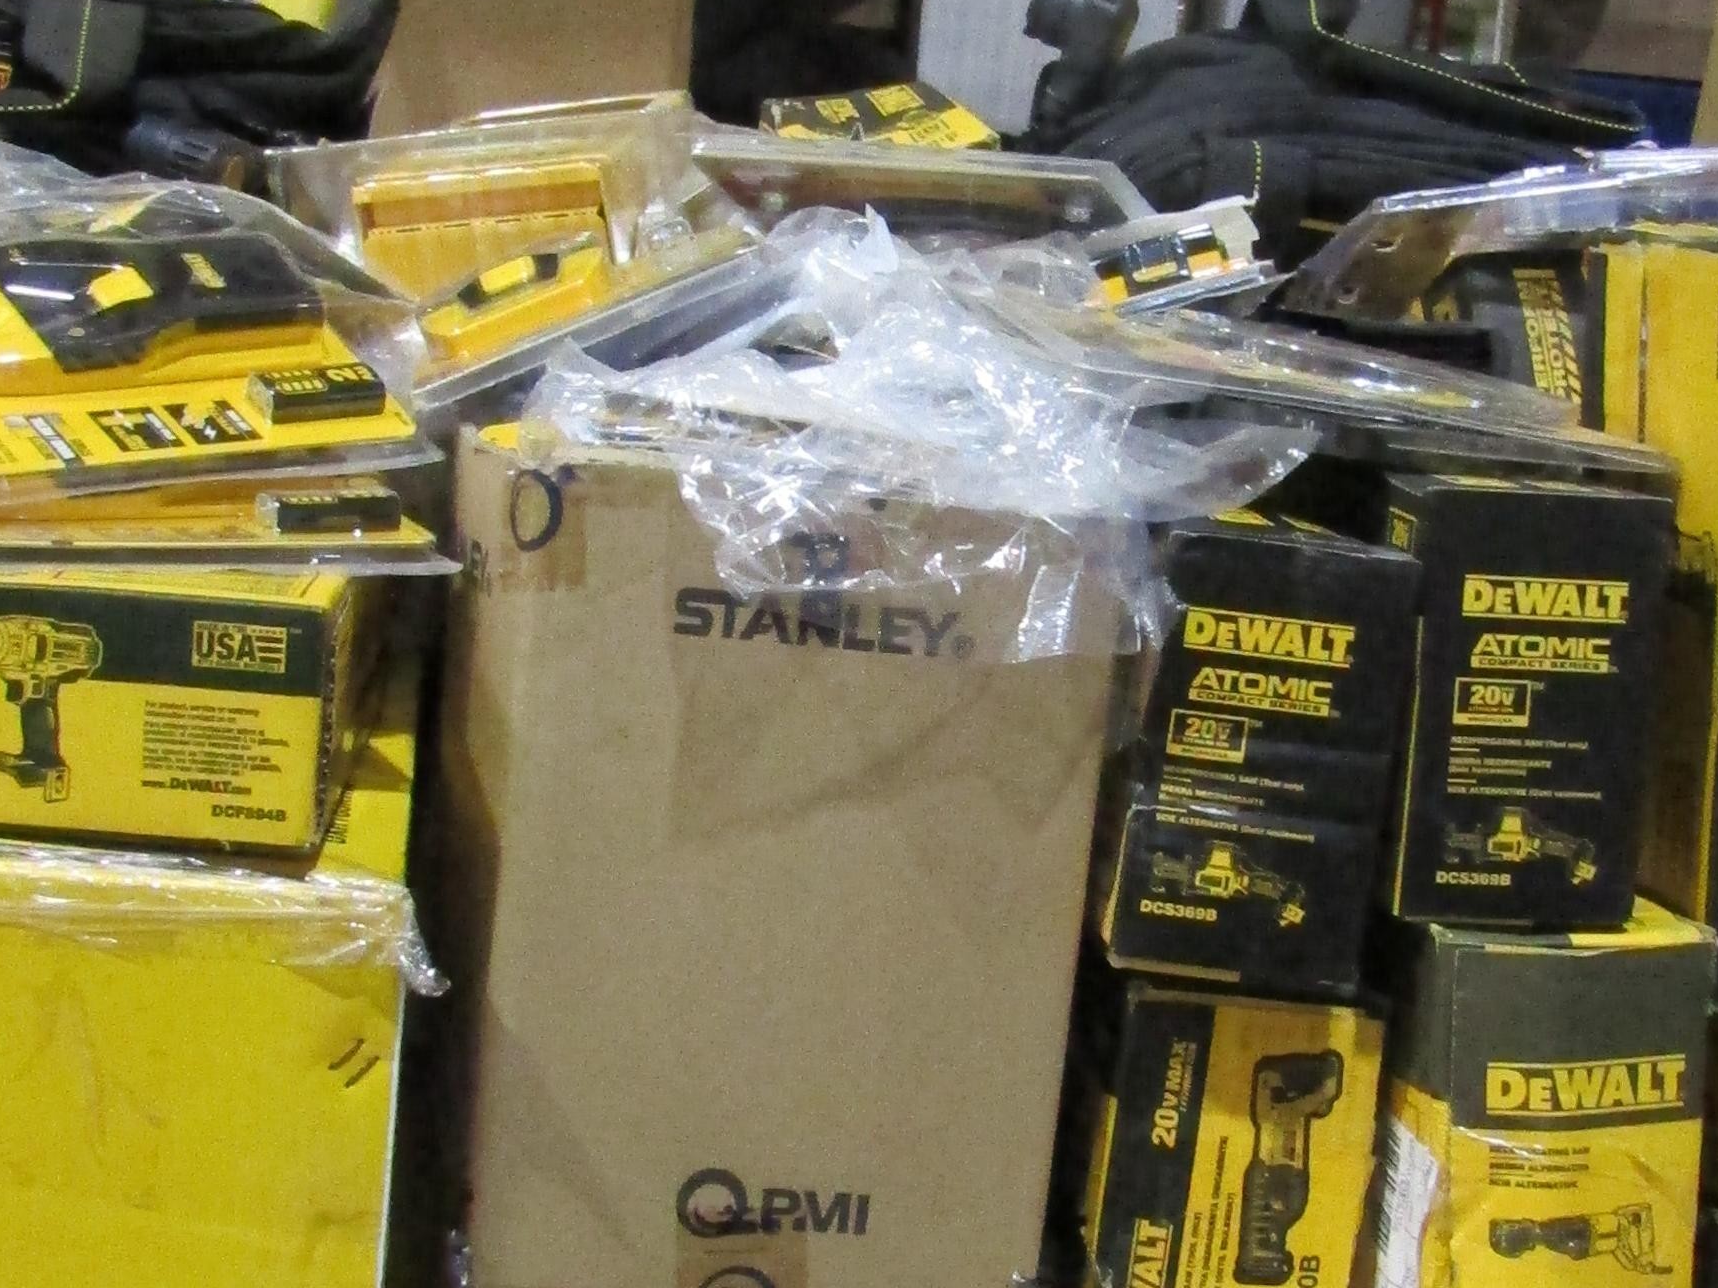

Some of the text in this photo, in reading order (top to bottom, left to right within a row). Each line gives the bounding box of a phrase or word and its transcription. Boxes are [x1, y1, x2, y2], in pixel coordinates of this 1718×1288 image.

[1461, 577, 1629, 621] DEWALT
[673, 587, 955, 657] STANLEY
[1184, 609, 1355, 664] DEWALT
[195, 631, 257, 662] USA
[1473, 634, 1612, 660] ATOMIC
[1191, 667, 1333, 702] ATOMIC
[1486, 1062, 1686, 1112] DEWALT
